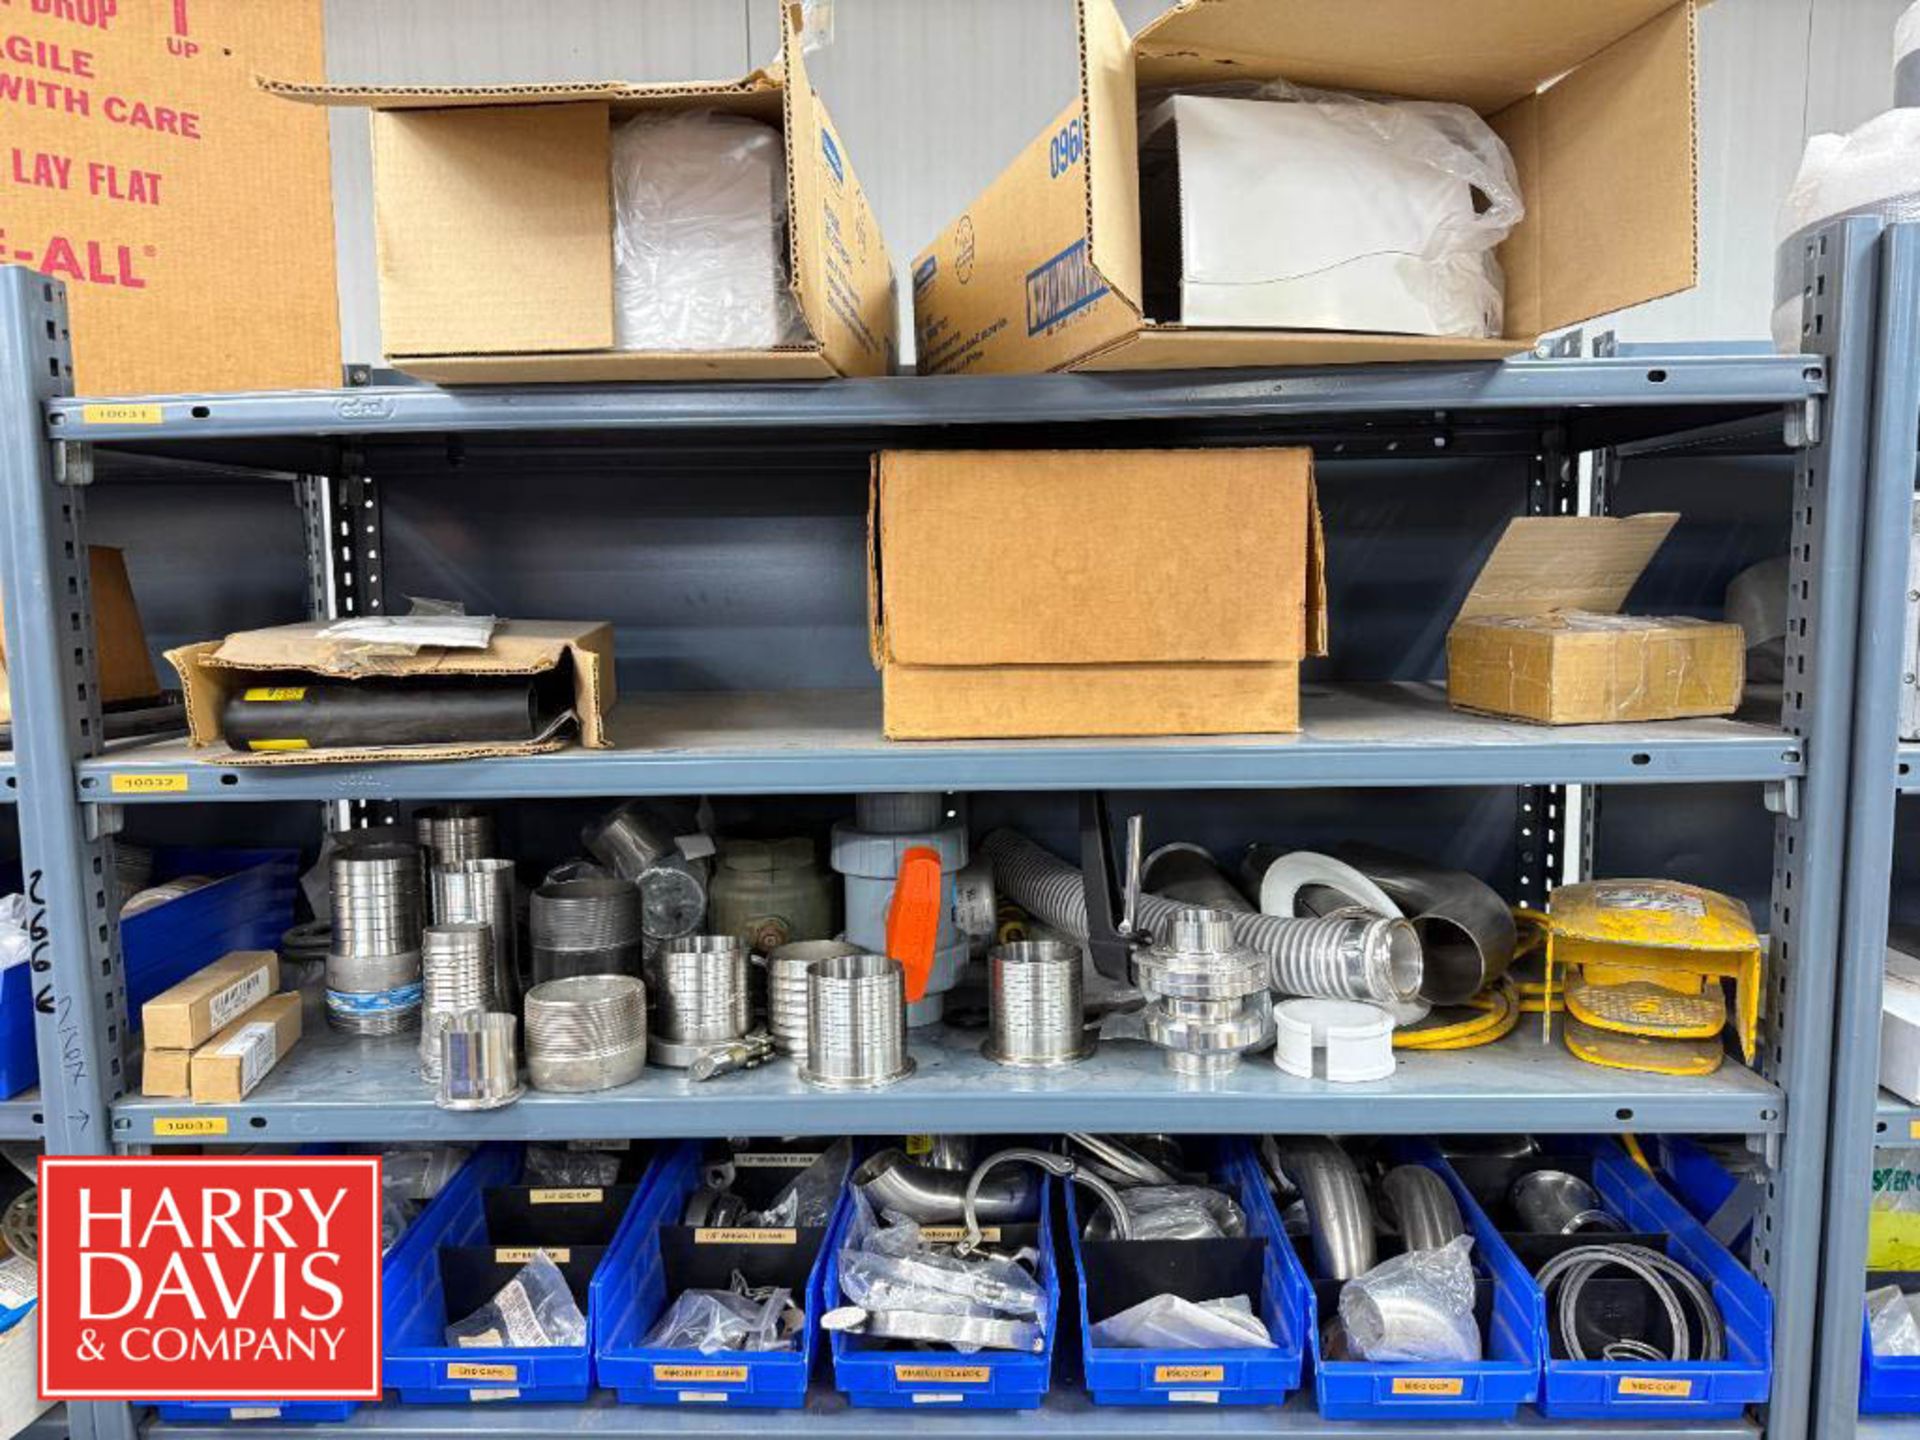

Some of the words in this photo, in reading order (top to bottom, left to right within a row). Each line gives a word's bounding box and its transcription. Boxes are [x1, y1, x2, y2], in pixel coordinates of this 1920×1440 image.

[0, 35, 95, 79] GILE
[166, 36, 199, 58] UP
[103, 96, 200, 140] CARE
[12, 148, 71, 190] LAY
[89, 162, 162, 205] FLAT
